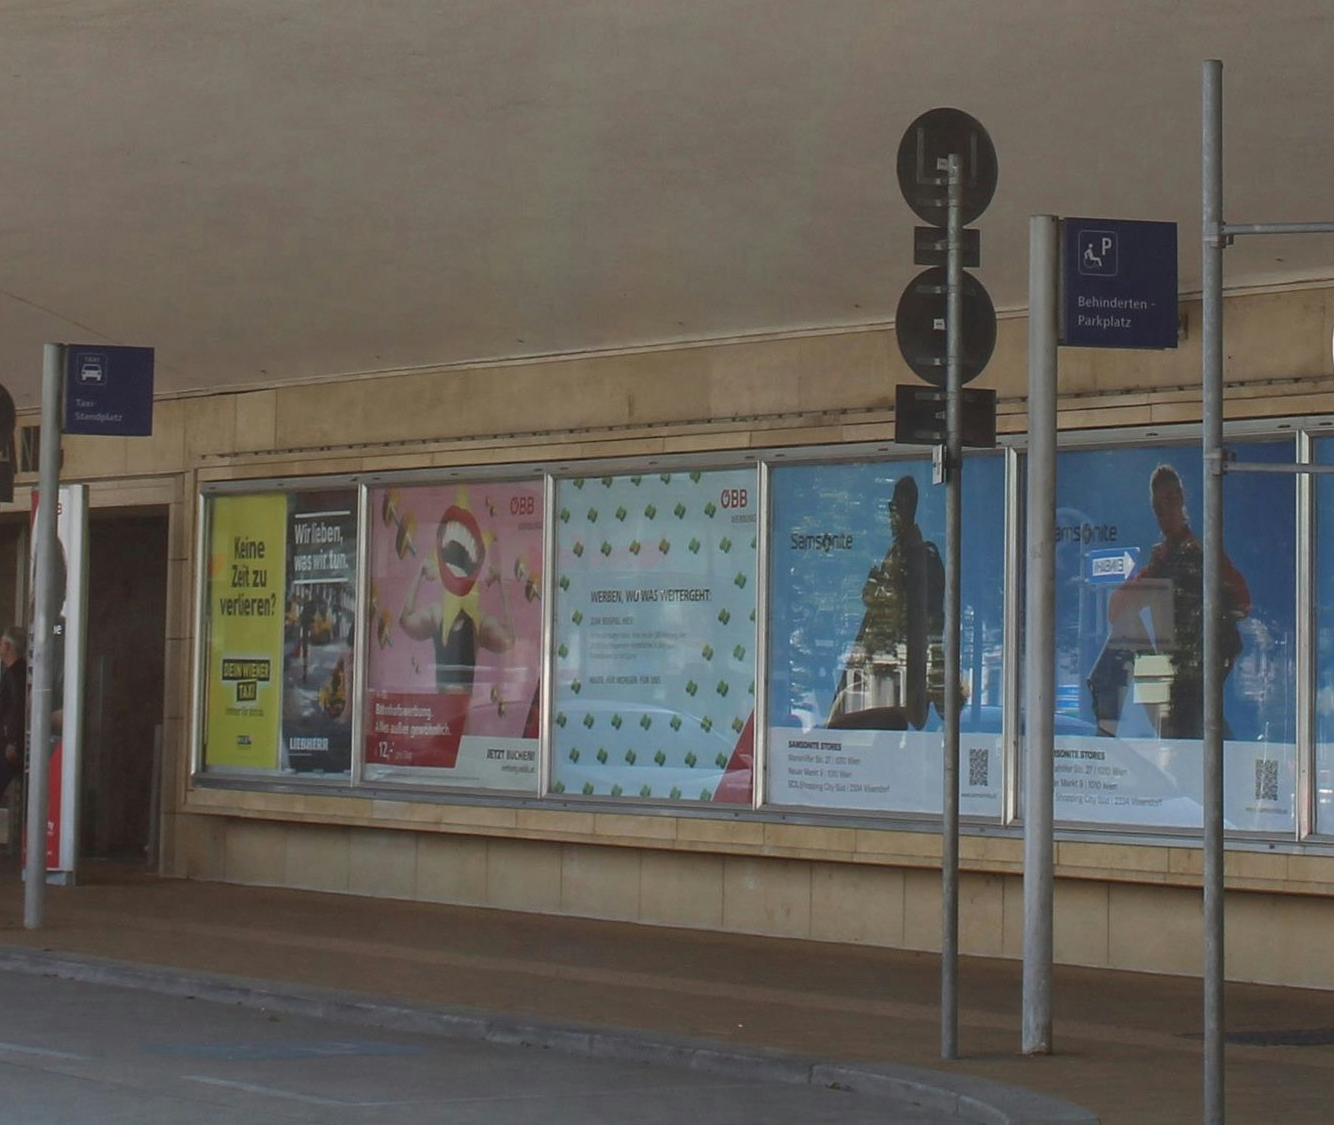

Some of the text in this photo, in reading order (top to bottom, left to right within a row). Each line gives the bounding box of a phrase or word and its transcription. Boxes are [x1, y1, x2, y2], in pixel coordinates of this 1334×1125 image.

[1102, 237, 1112, 255] P
[1078, 296, 1147, 309] Behinderten
[1078, 315, 1132, 329] Parkplatz
[75, 412, 123, 422] Standplatz
[721, 489, 747, 509] ÖBB
[294, 522, 343, 546] Wir lieben,
[1055, 523, 1117, 545] amsonite
[234, 536, 265, 559] Keine
[790, 533, 853, 553] Samsonite
[294, 554, 312, 571] was
[232, 565, 267, 588] Zeit zu
[220, 593, 276, 616] verlieren?
[591, 590, 624, 603] WERBEN,
[641, 589, 658, 602] WAS
[289, 737, 329, 751] LIEBHERR
[788, 740, 842, 752] SAMSONITE STORES
[1053, 749, 1105, 760] SONITE STORES
